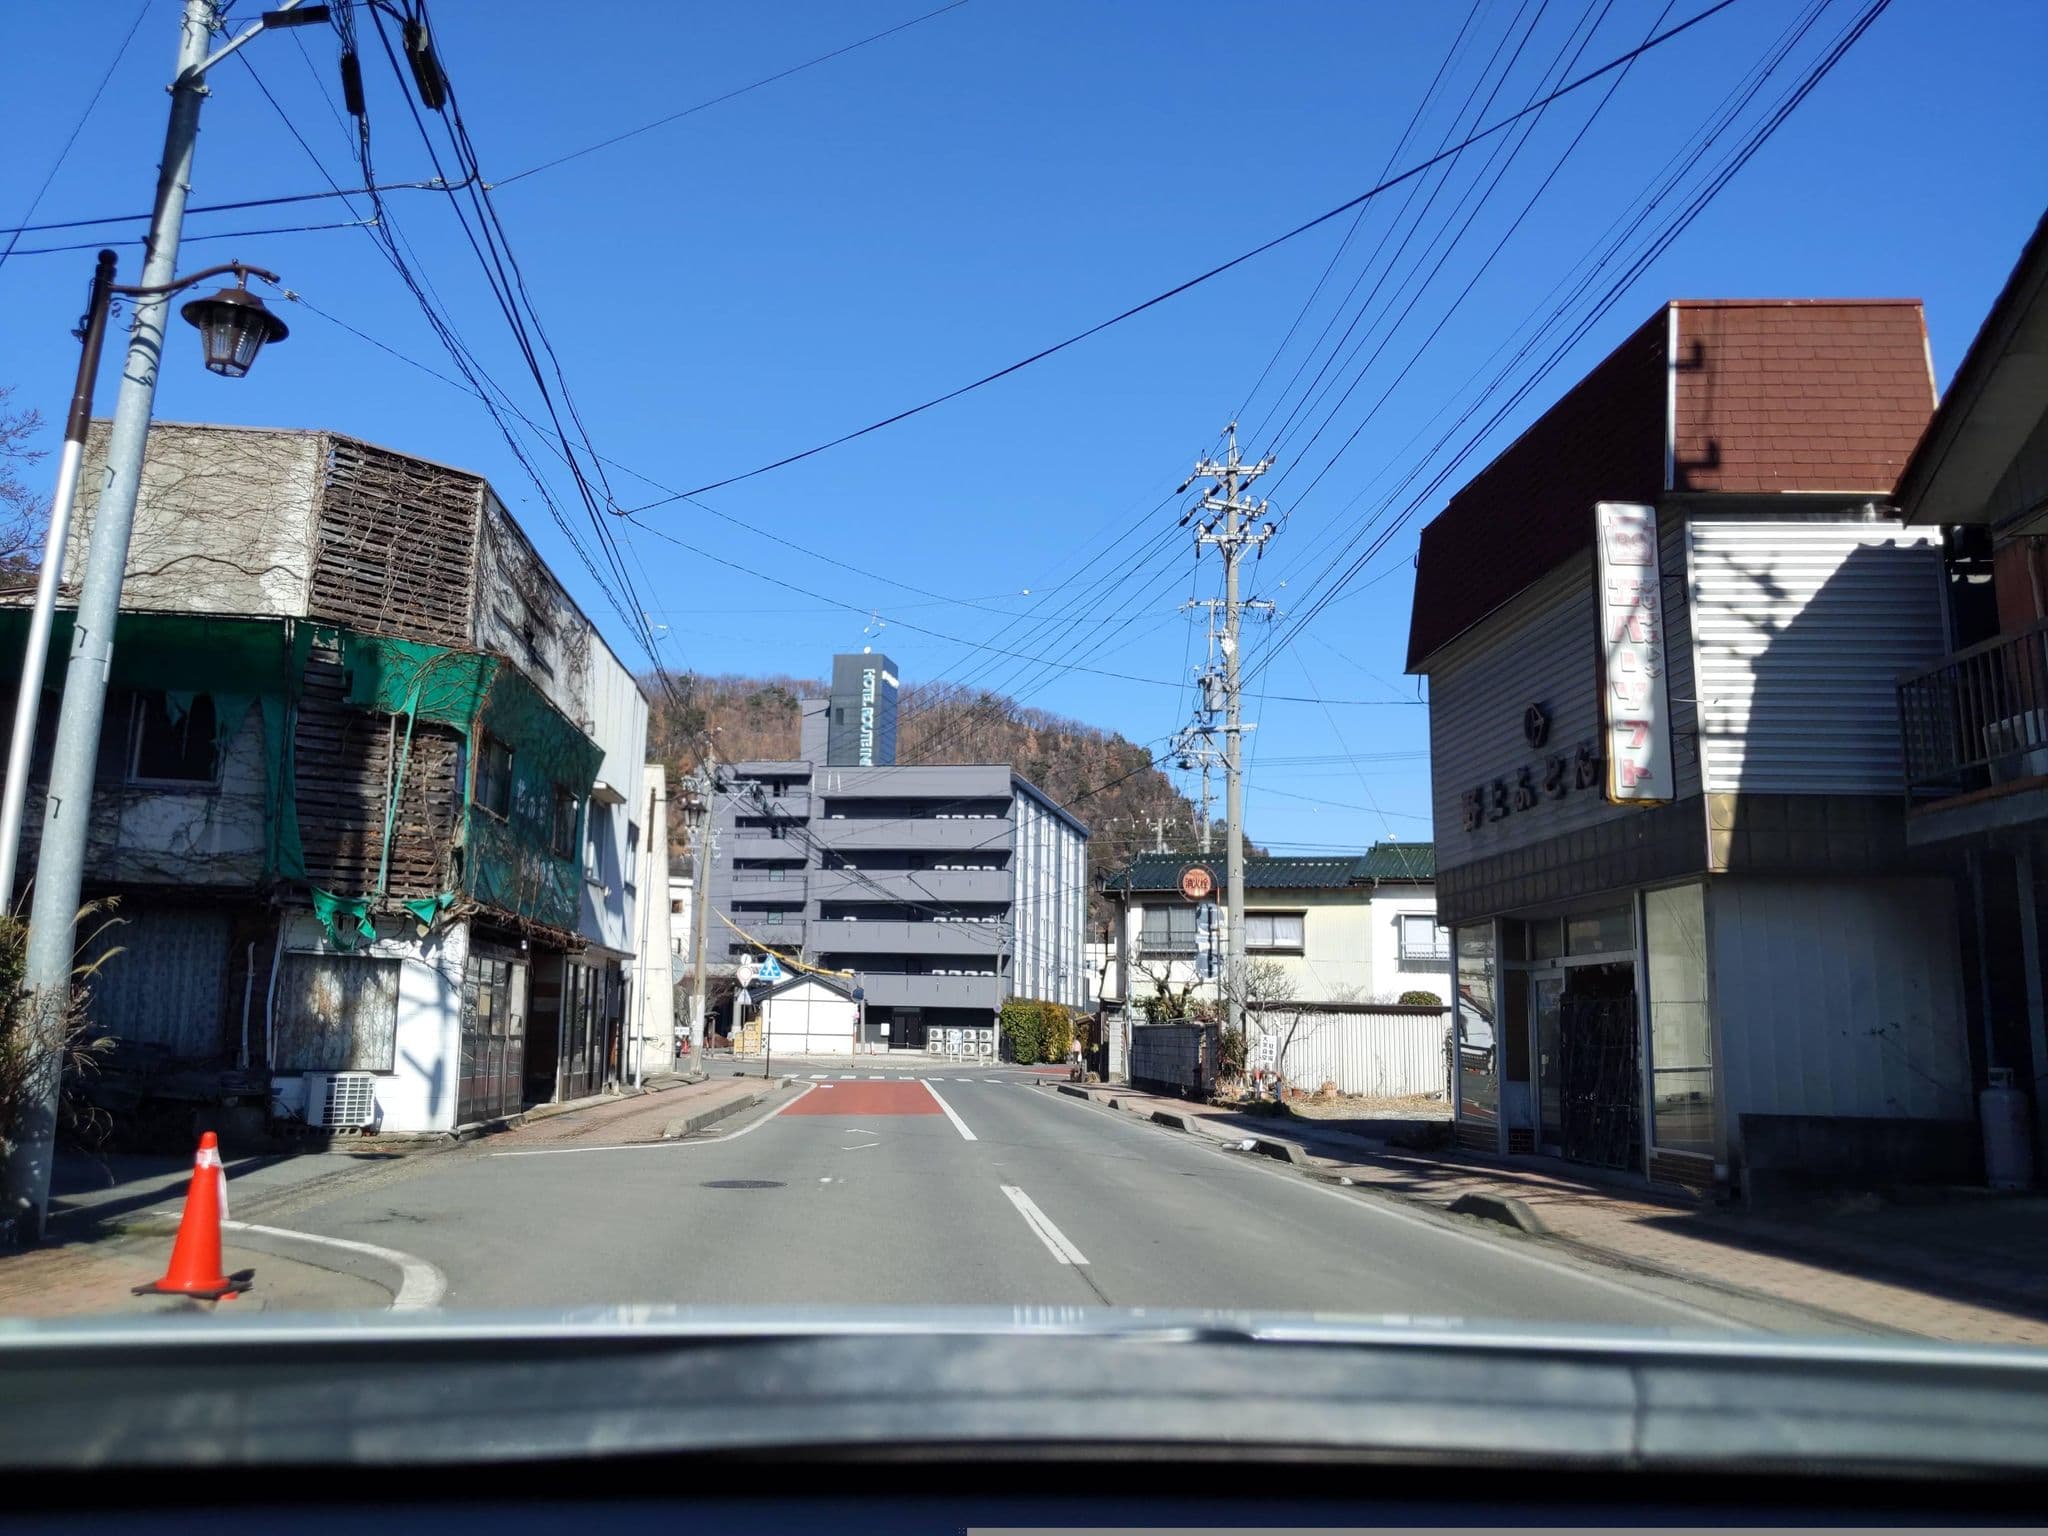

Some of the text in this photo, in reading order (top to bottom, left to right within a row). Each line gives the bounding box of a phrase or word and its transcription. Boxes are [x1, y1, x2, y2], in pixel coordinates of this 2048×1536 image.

[862, 668, 876, 706] HOTEL
[1185, 877, 1208, 889] 消火栓
